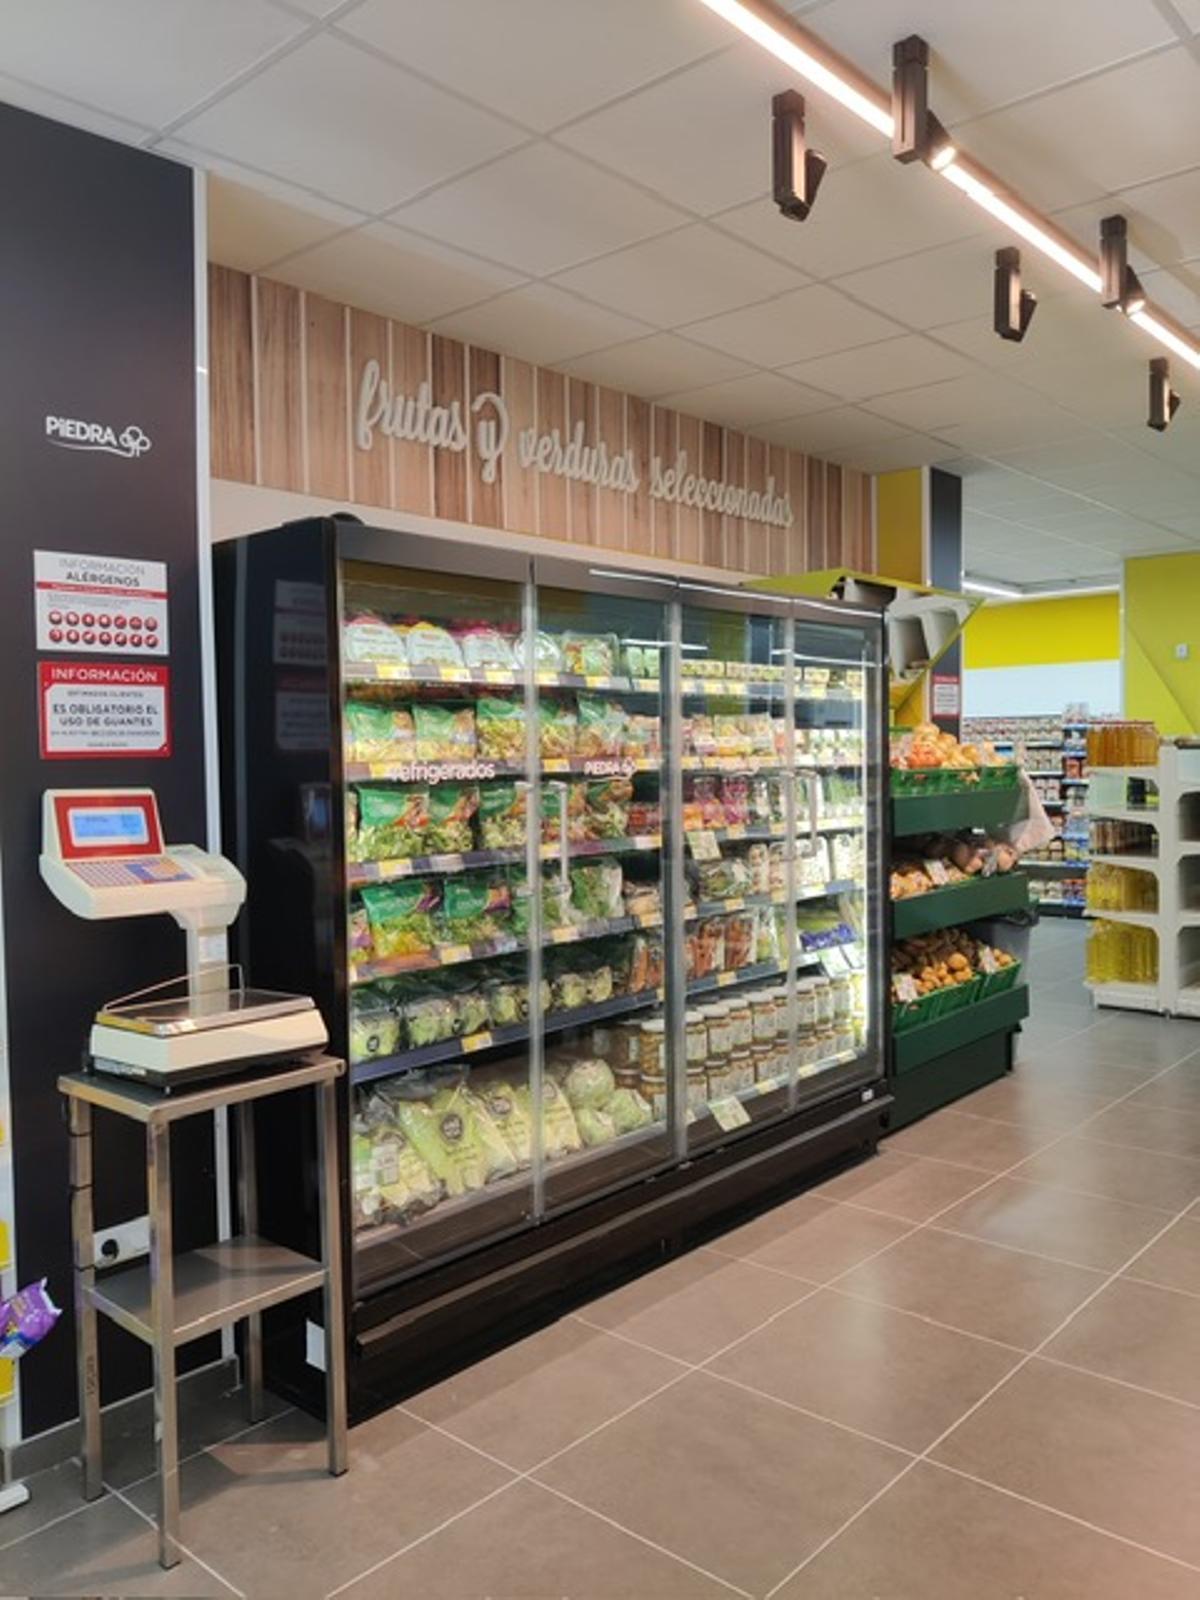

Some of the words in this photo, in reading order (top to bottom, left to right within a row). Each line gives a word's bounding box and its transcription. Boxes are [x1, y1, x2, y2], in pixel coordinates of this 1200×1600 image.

[46, 416, 118, 447] PIEDRA
[357, 359, 468, 452] frutas
[472, 391, 510, 483] y
[518, 421, 640, 494] verduras
[648, 447, 795, 528] seleccionadas
[51, 667, 158, 682] INFORMACIÓN
[53, 703, 67, 715] ES
[69, 704, 144, 715] OBLIGATORIO
[146, 705, 159, 715] EL
[59, 717, 83, 727] USO
[86, 717, 100, 727] DE
[104, 717, 153, 727] GUANTES
